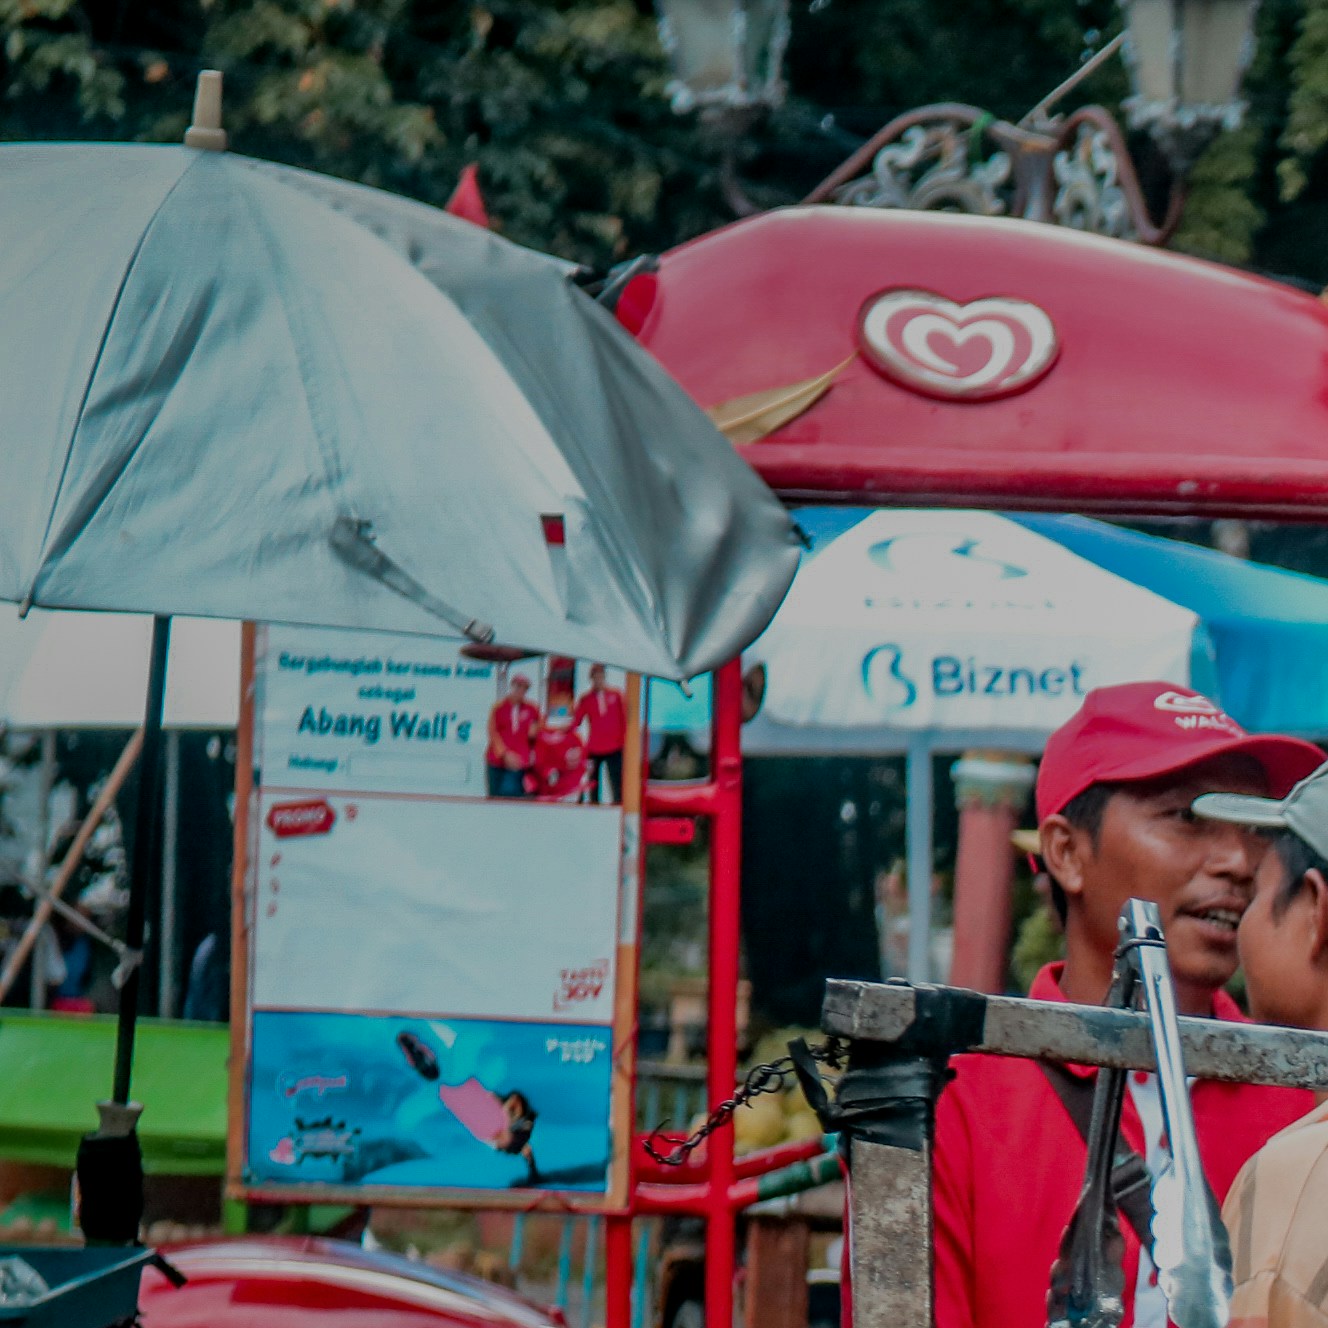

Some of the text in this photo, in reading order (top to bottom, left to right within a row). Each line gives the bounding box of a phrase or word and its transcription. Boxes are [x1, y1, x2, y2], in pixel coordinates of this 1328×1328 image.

[931, 655, 1087, 697] Biznet
[298, 703, 473, 746] Abang Wall's
